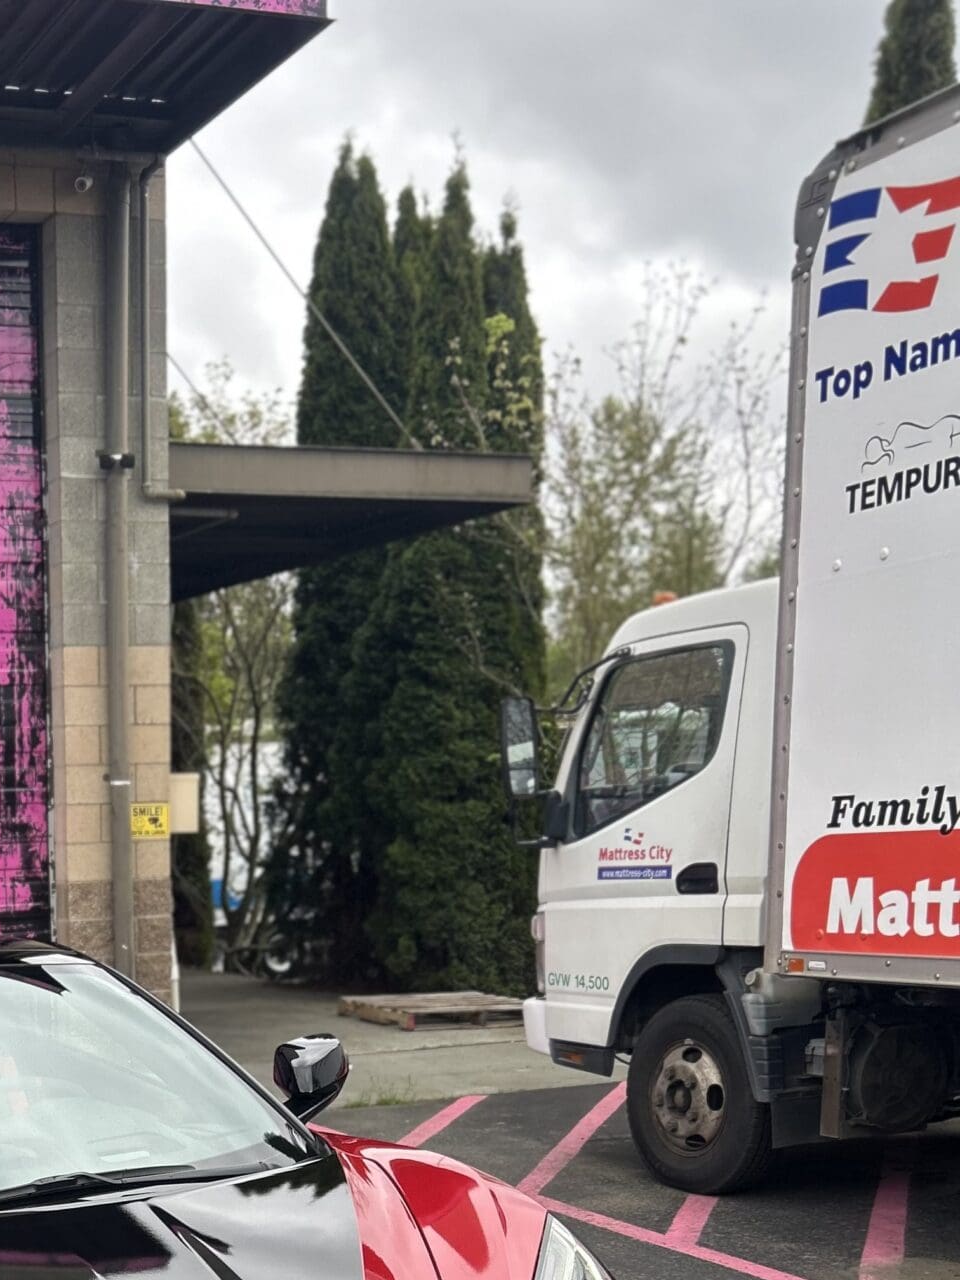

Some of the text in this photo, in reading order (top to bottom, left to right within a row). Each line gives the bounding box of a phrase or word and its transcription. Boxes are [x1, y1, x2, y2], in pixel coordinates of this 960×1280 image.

[815, 329, 960, 403] Top Nam
[846, 456, 960, 514] TEMPUR
[133, 807, 163, 817] SMILE!
[827, 785, 960, 836] Family
[599, 846, 672, 863] Mattress City
[826, 877, 960, 937] Matt
[548, 972, 609, 991] GVW 14,500
